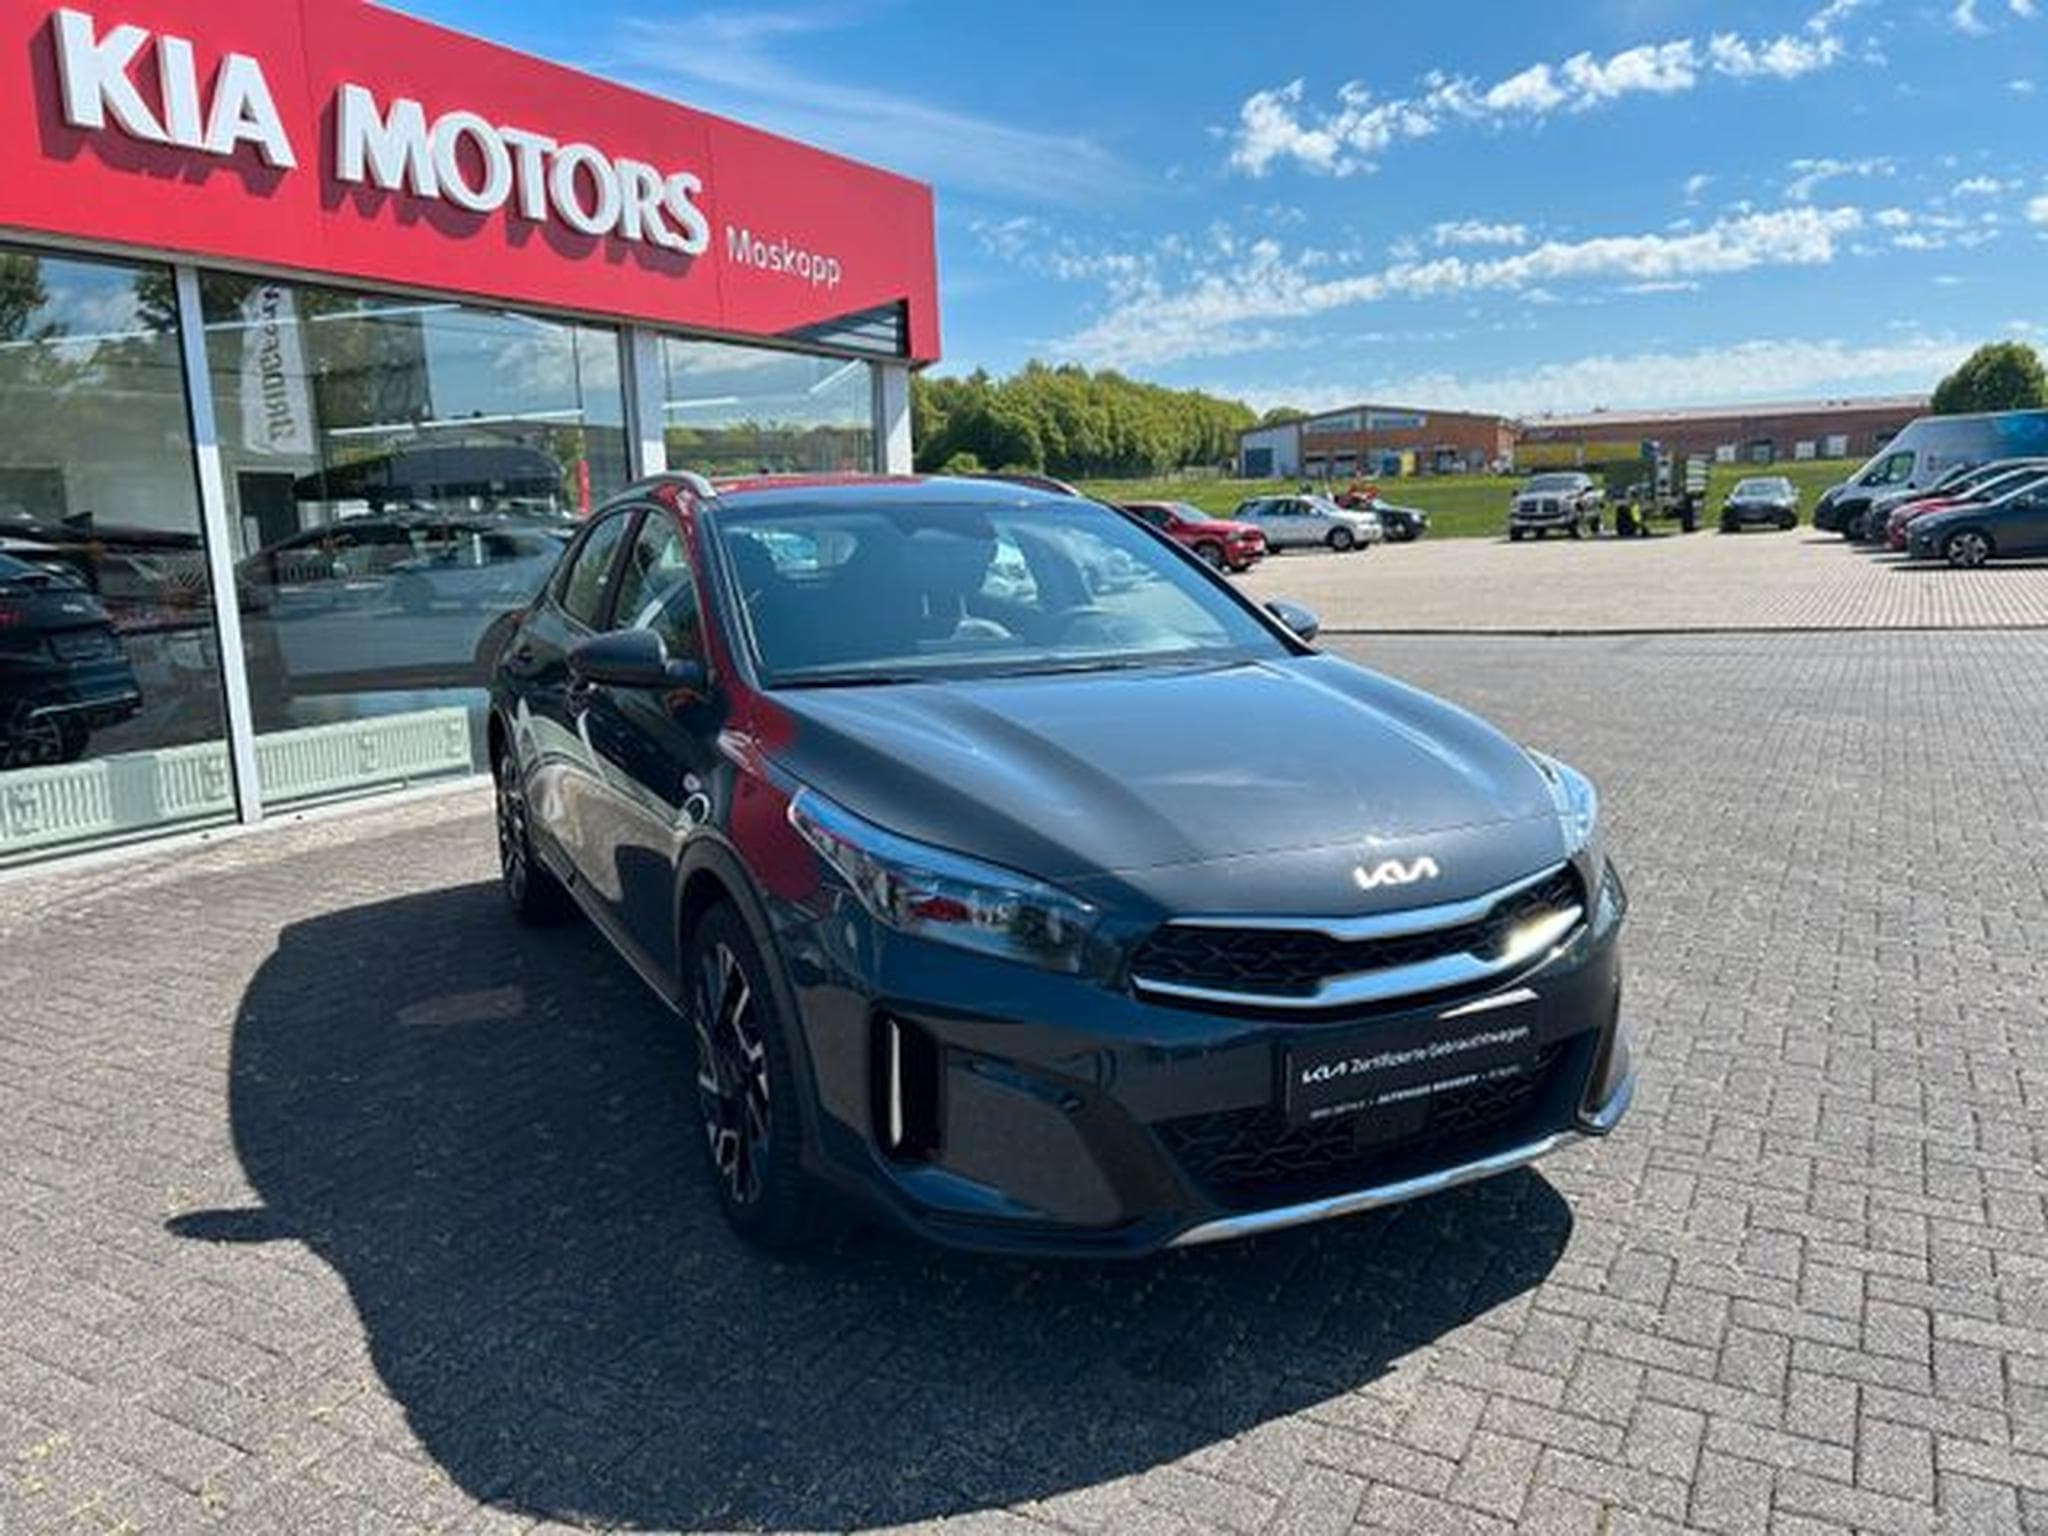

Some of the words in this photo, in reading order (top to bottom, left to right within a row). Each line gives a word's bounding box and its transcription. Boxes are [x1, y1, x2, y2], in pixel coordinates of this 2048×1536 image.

[52, 8, 298, 169] KIA
[336, 82, 710, 255] MOTORS
[726, 225, 841, 290] Moskopp
[1353, 856, 1439, 890] KIA
[1302, 1061, 1347, 1083] KIA
